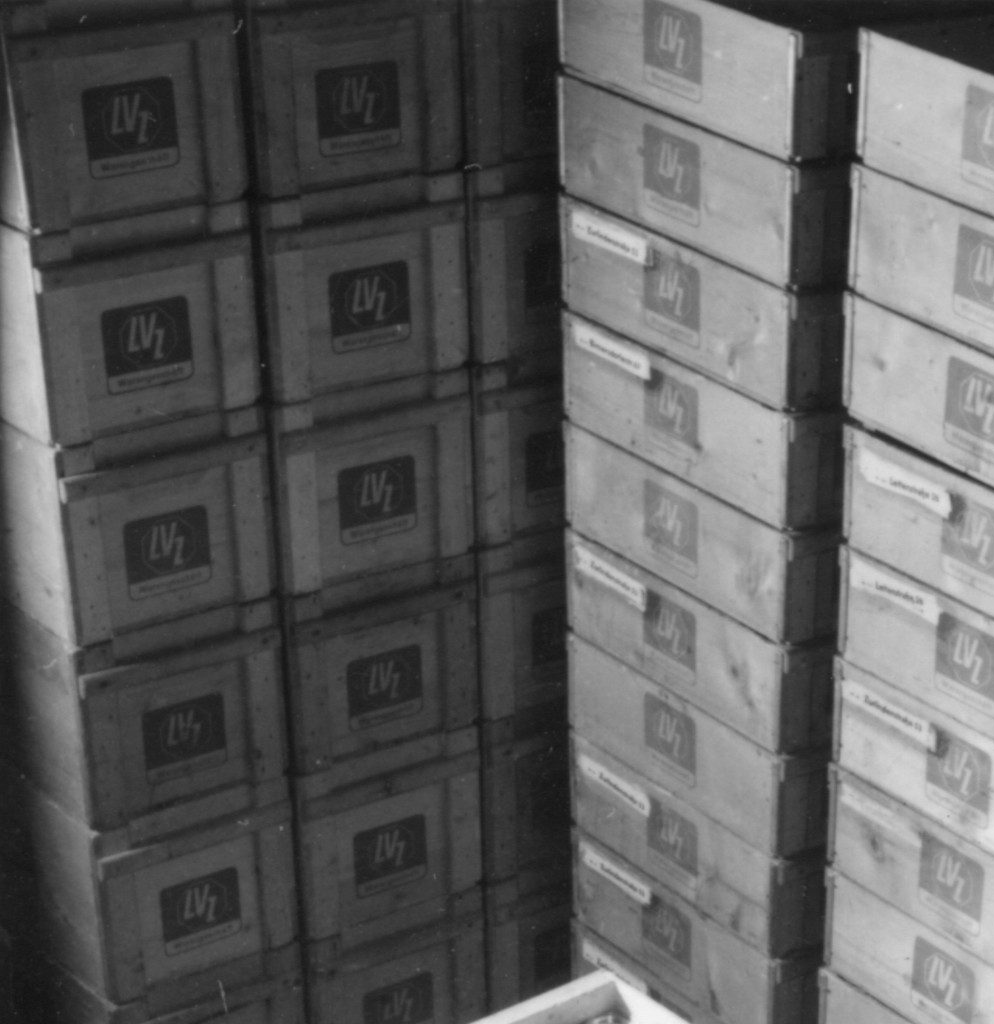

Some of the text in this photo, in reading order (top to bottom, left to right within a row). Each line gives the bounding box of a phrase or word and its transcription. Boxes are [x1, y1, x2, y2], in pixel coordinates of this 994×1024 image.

[109, 92, 149, 144] LVZ
[352, 279, 387, 322] LVZ
[128, 313, 165, 360] LVZ
